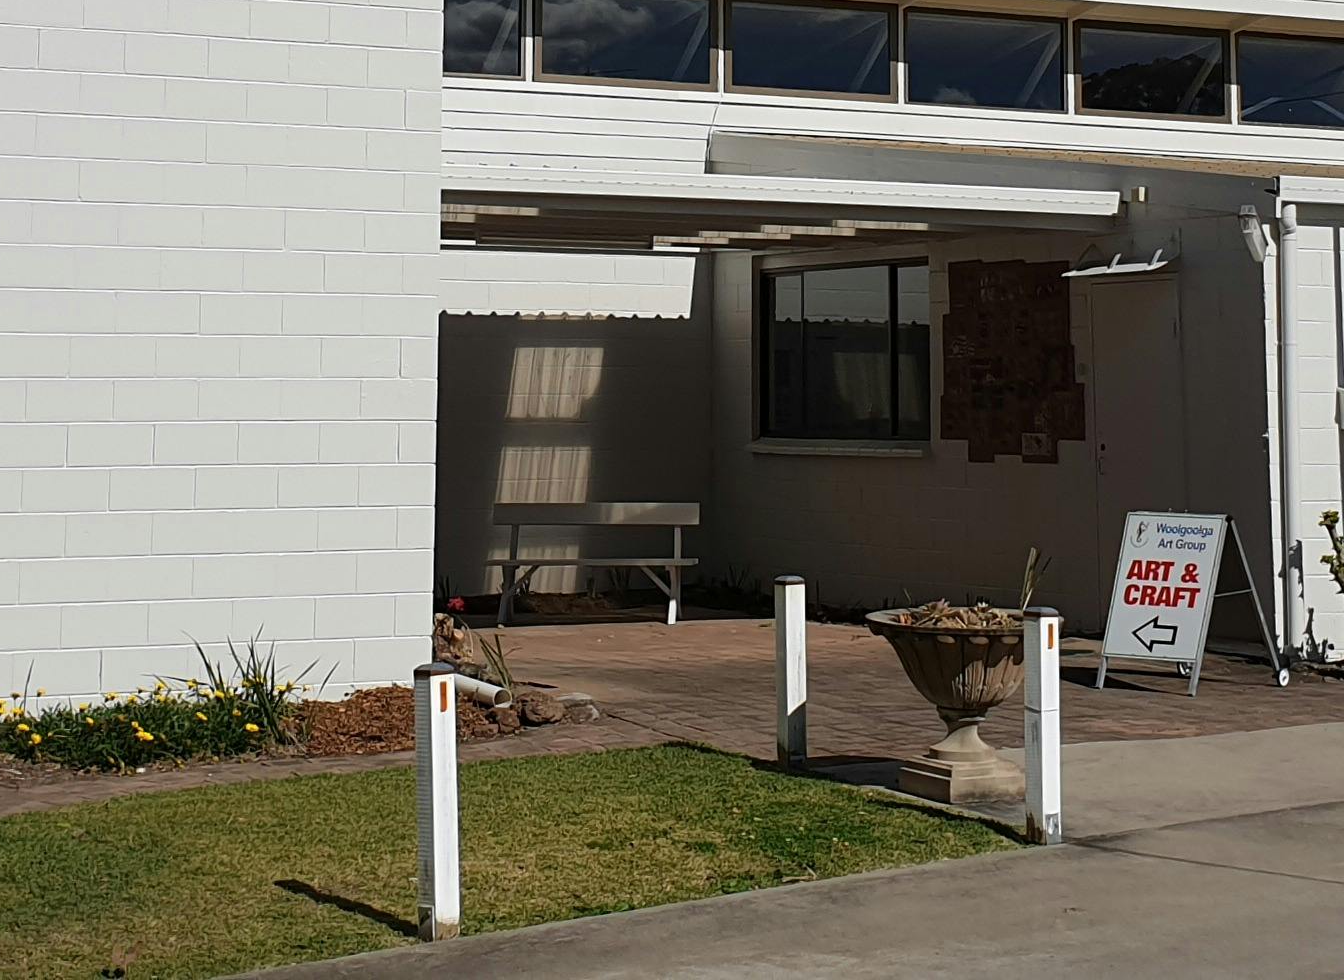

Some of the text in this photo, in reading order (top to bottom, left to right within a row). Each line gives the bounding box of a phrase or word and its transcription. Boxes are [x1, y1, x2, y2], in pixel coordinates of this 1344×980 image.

[1156, 523, 1214, 538] Woolgoolga
[1157, 538, 1206, 552] Art Group
[1126, 559, 1199, 583] ART &
[1123, 584, 1201, 609] CRAFT
